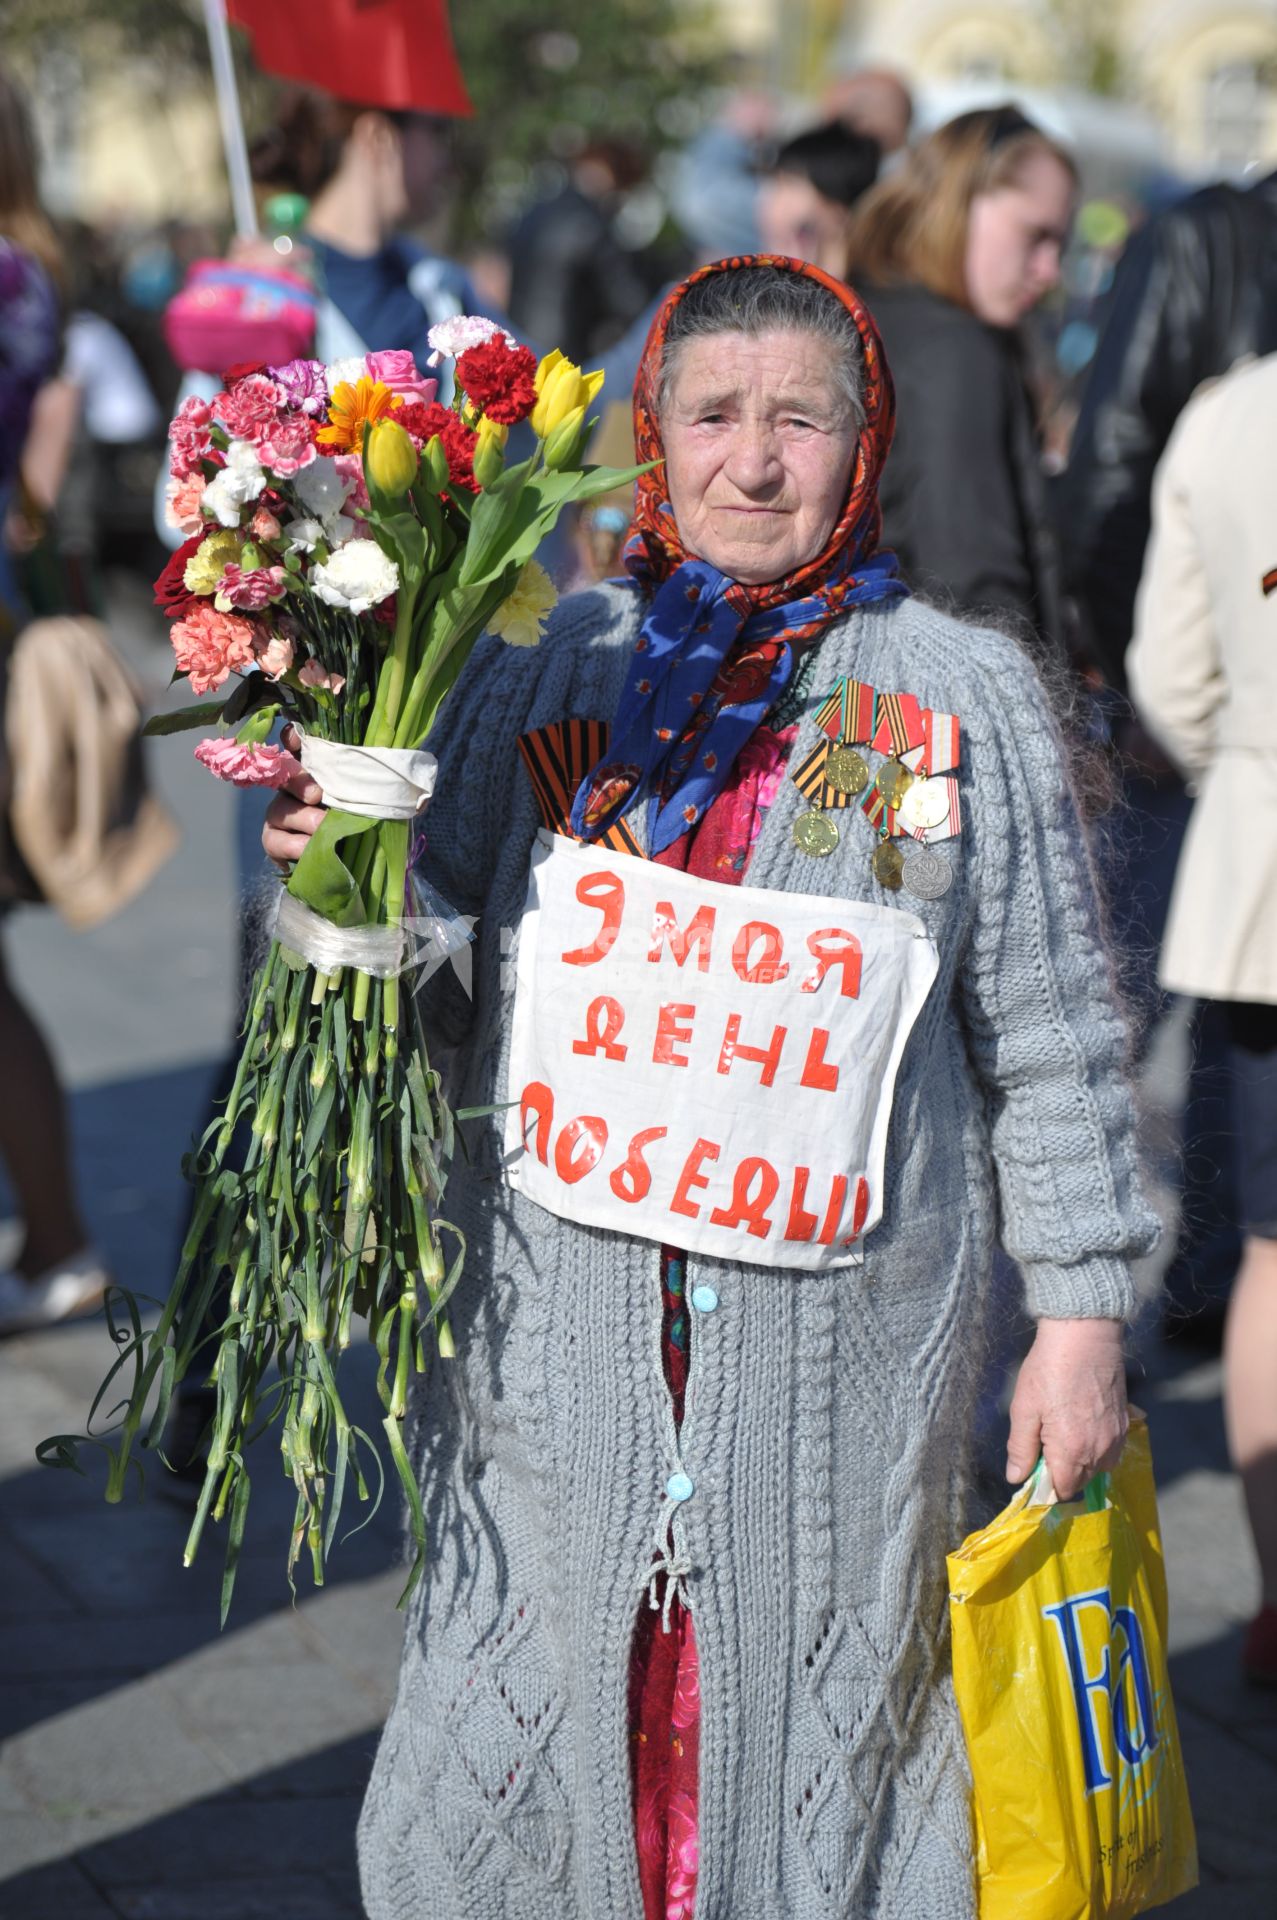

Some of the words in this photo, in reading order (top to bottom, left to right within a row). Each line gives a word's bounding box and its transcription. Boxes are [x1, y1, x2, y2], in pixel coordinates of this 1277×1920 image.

[647, 901, 864, 1000] МОЯ
[572, 995, 840, 1092] ДЕНЬ
[520, 1081, 871, 1247] ПОБЕДЫ!
[1041, 1586, 1161, 1799] Fa
